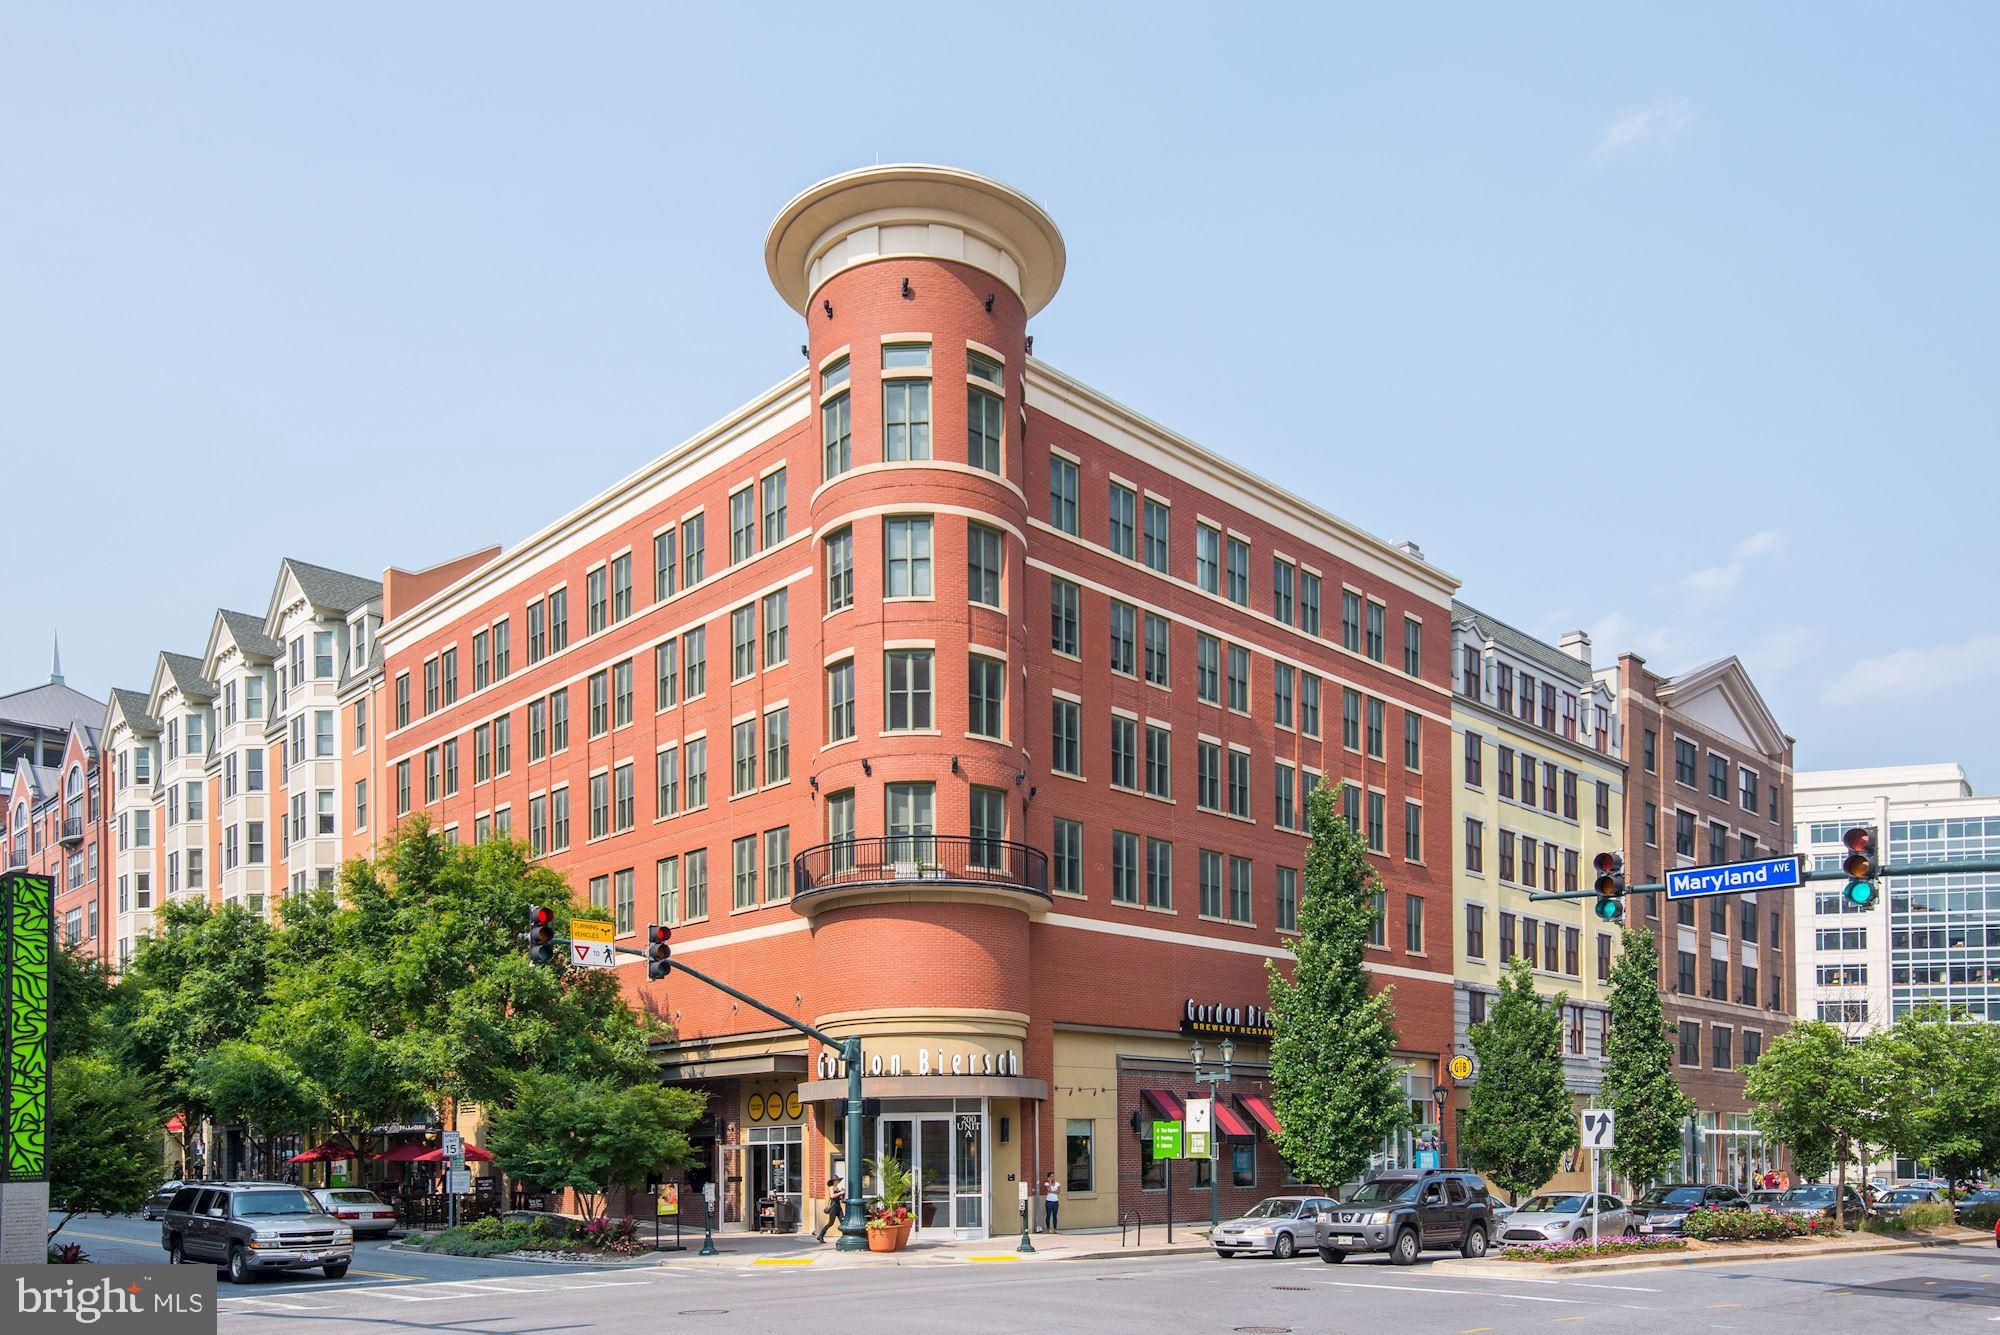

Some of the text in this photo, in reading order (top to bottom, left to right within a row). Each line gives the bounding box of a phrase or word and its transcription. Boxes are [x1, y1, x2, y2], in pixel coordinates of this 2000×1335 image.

[1673, 862, 1790, 892] Maryland AVE
[573, 922, 599, 930] TURNING
[1187, 998, 1271, 1028] Gordon Bie
[1193, 1022, 1236, 1033] BREWERY
[919, 1048, 1017, 1077] Biersch
[961, 1115, 976, 1123] 200
[957, 1122, 981, 1130] UNIT
[445, 1144, 456, 1153] 15
